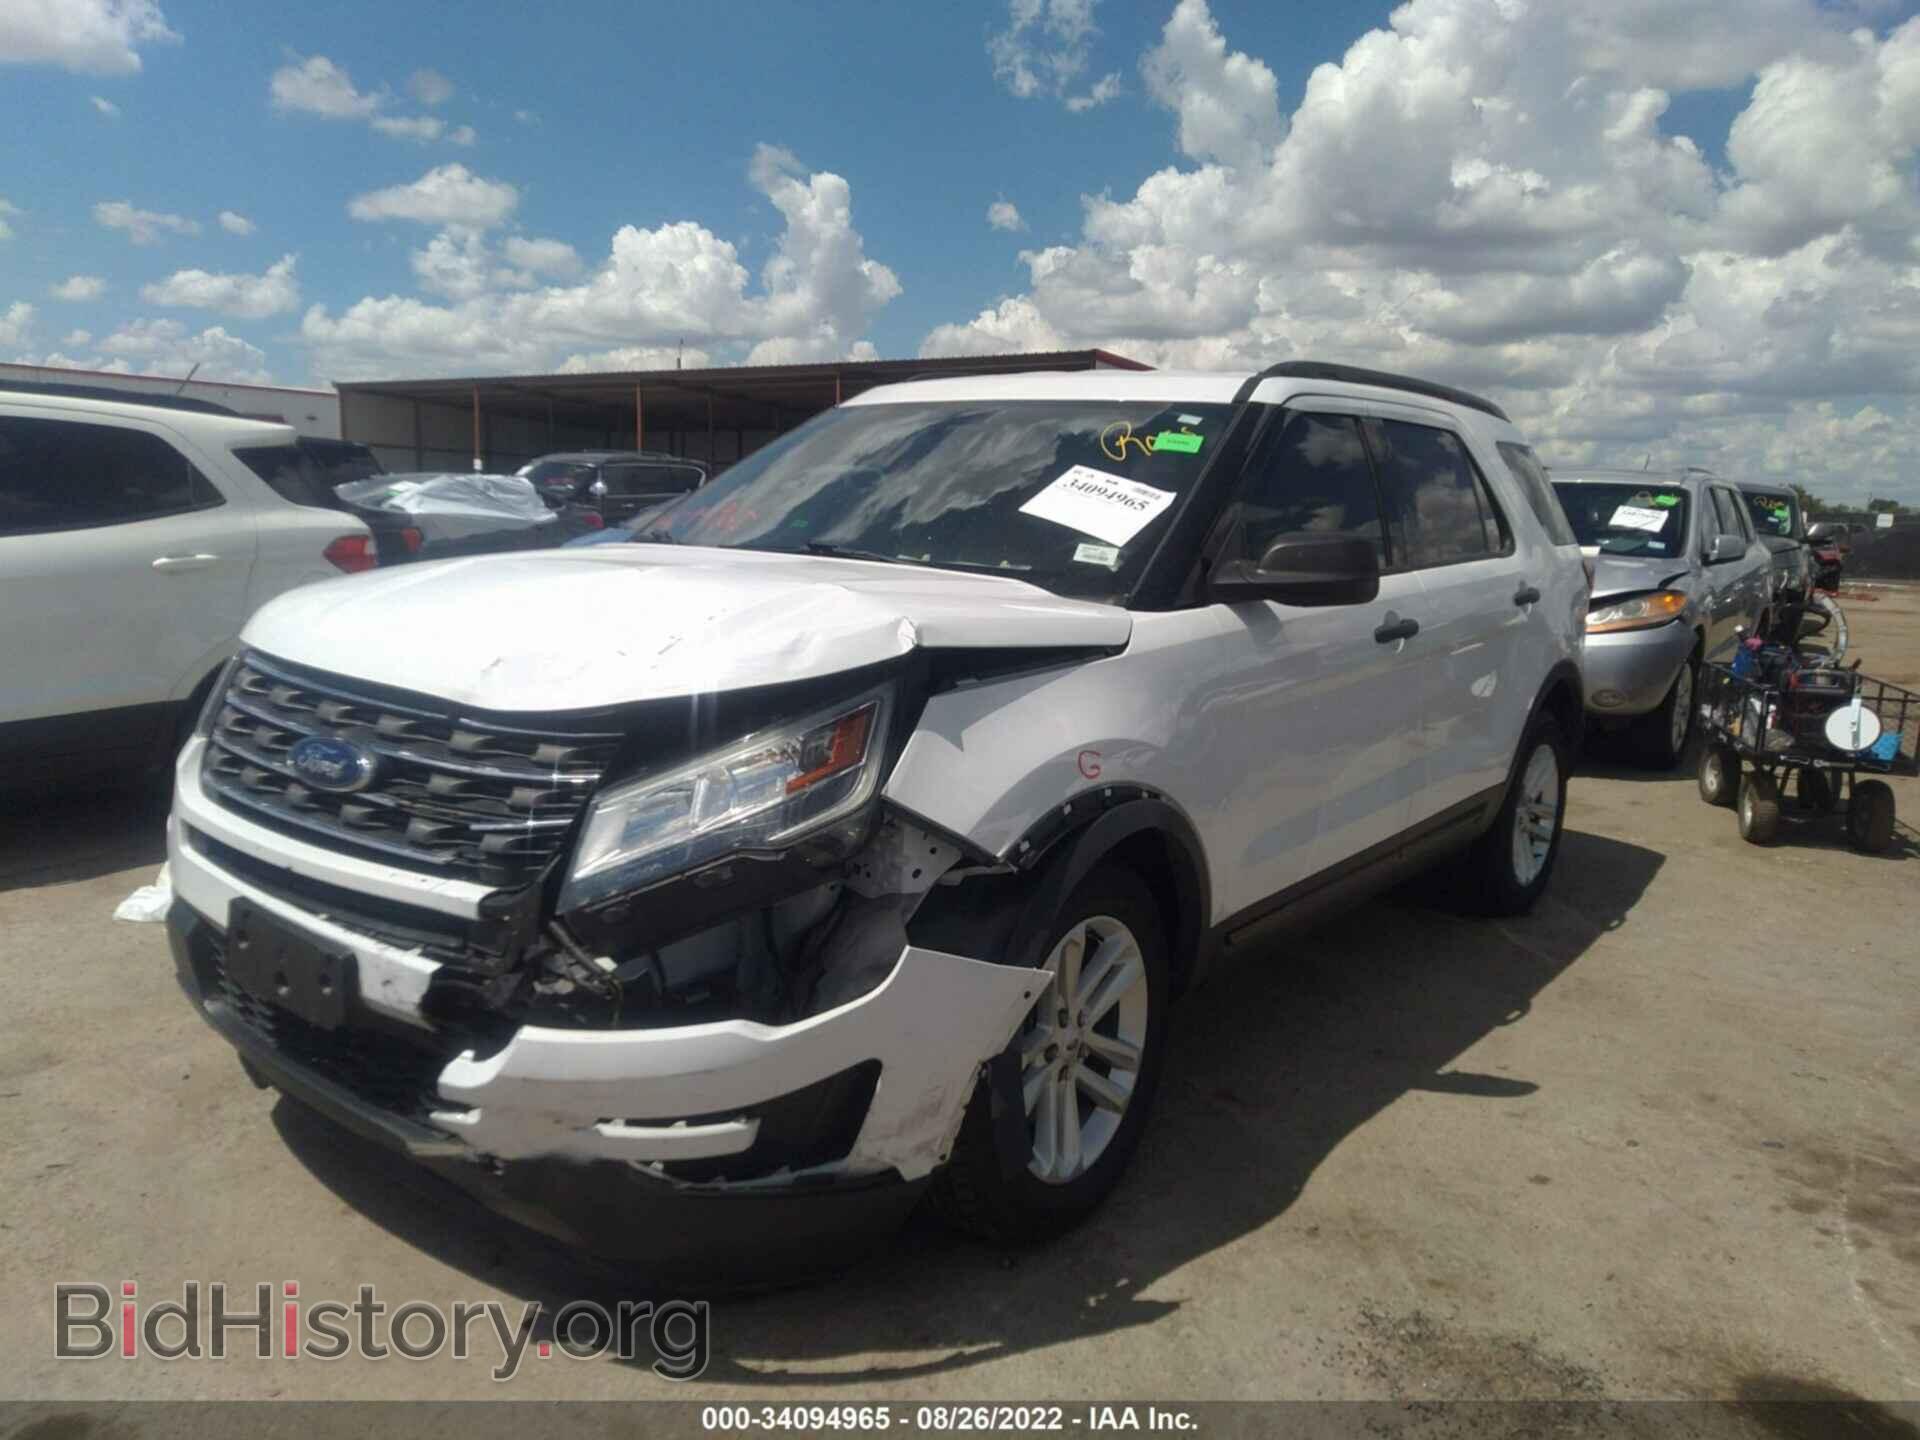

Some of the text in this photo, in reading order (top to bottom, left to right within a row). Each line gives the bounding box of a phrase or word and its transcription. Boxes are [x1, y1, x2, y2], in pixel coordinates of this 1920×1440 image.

[1063, 479, 1150, 511] 34094965
[298, 744, 346, 778] Ford
[1078, 750, 1102, 780] G
